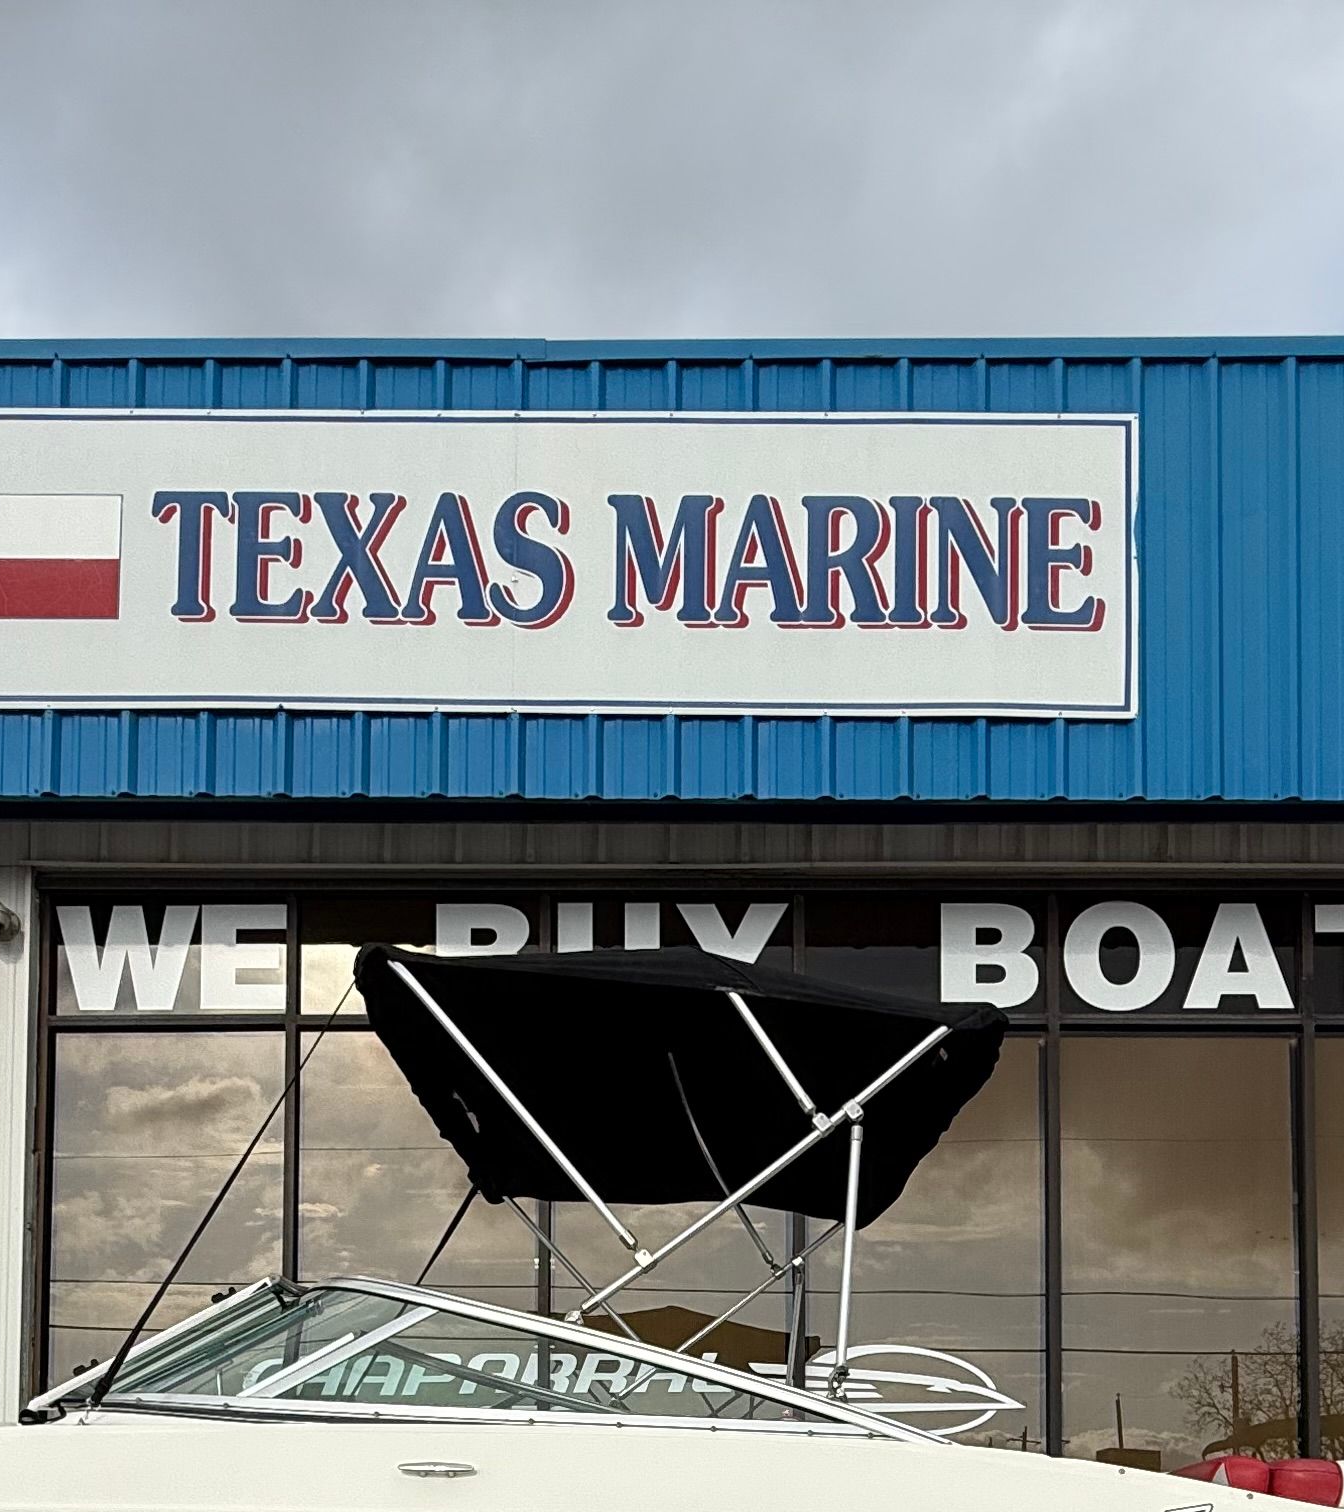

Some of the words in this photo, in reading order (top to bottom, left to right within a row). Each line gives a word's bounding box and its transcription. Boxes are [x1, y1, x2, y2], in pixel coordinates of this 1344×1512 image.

[151, 491, 575, 631] TEXAS
[607, 494, 1103, 632] MARINE
[56, 904, 287, 1011] WE
